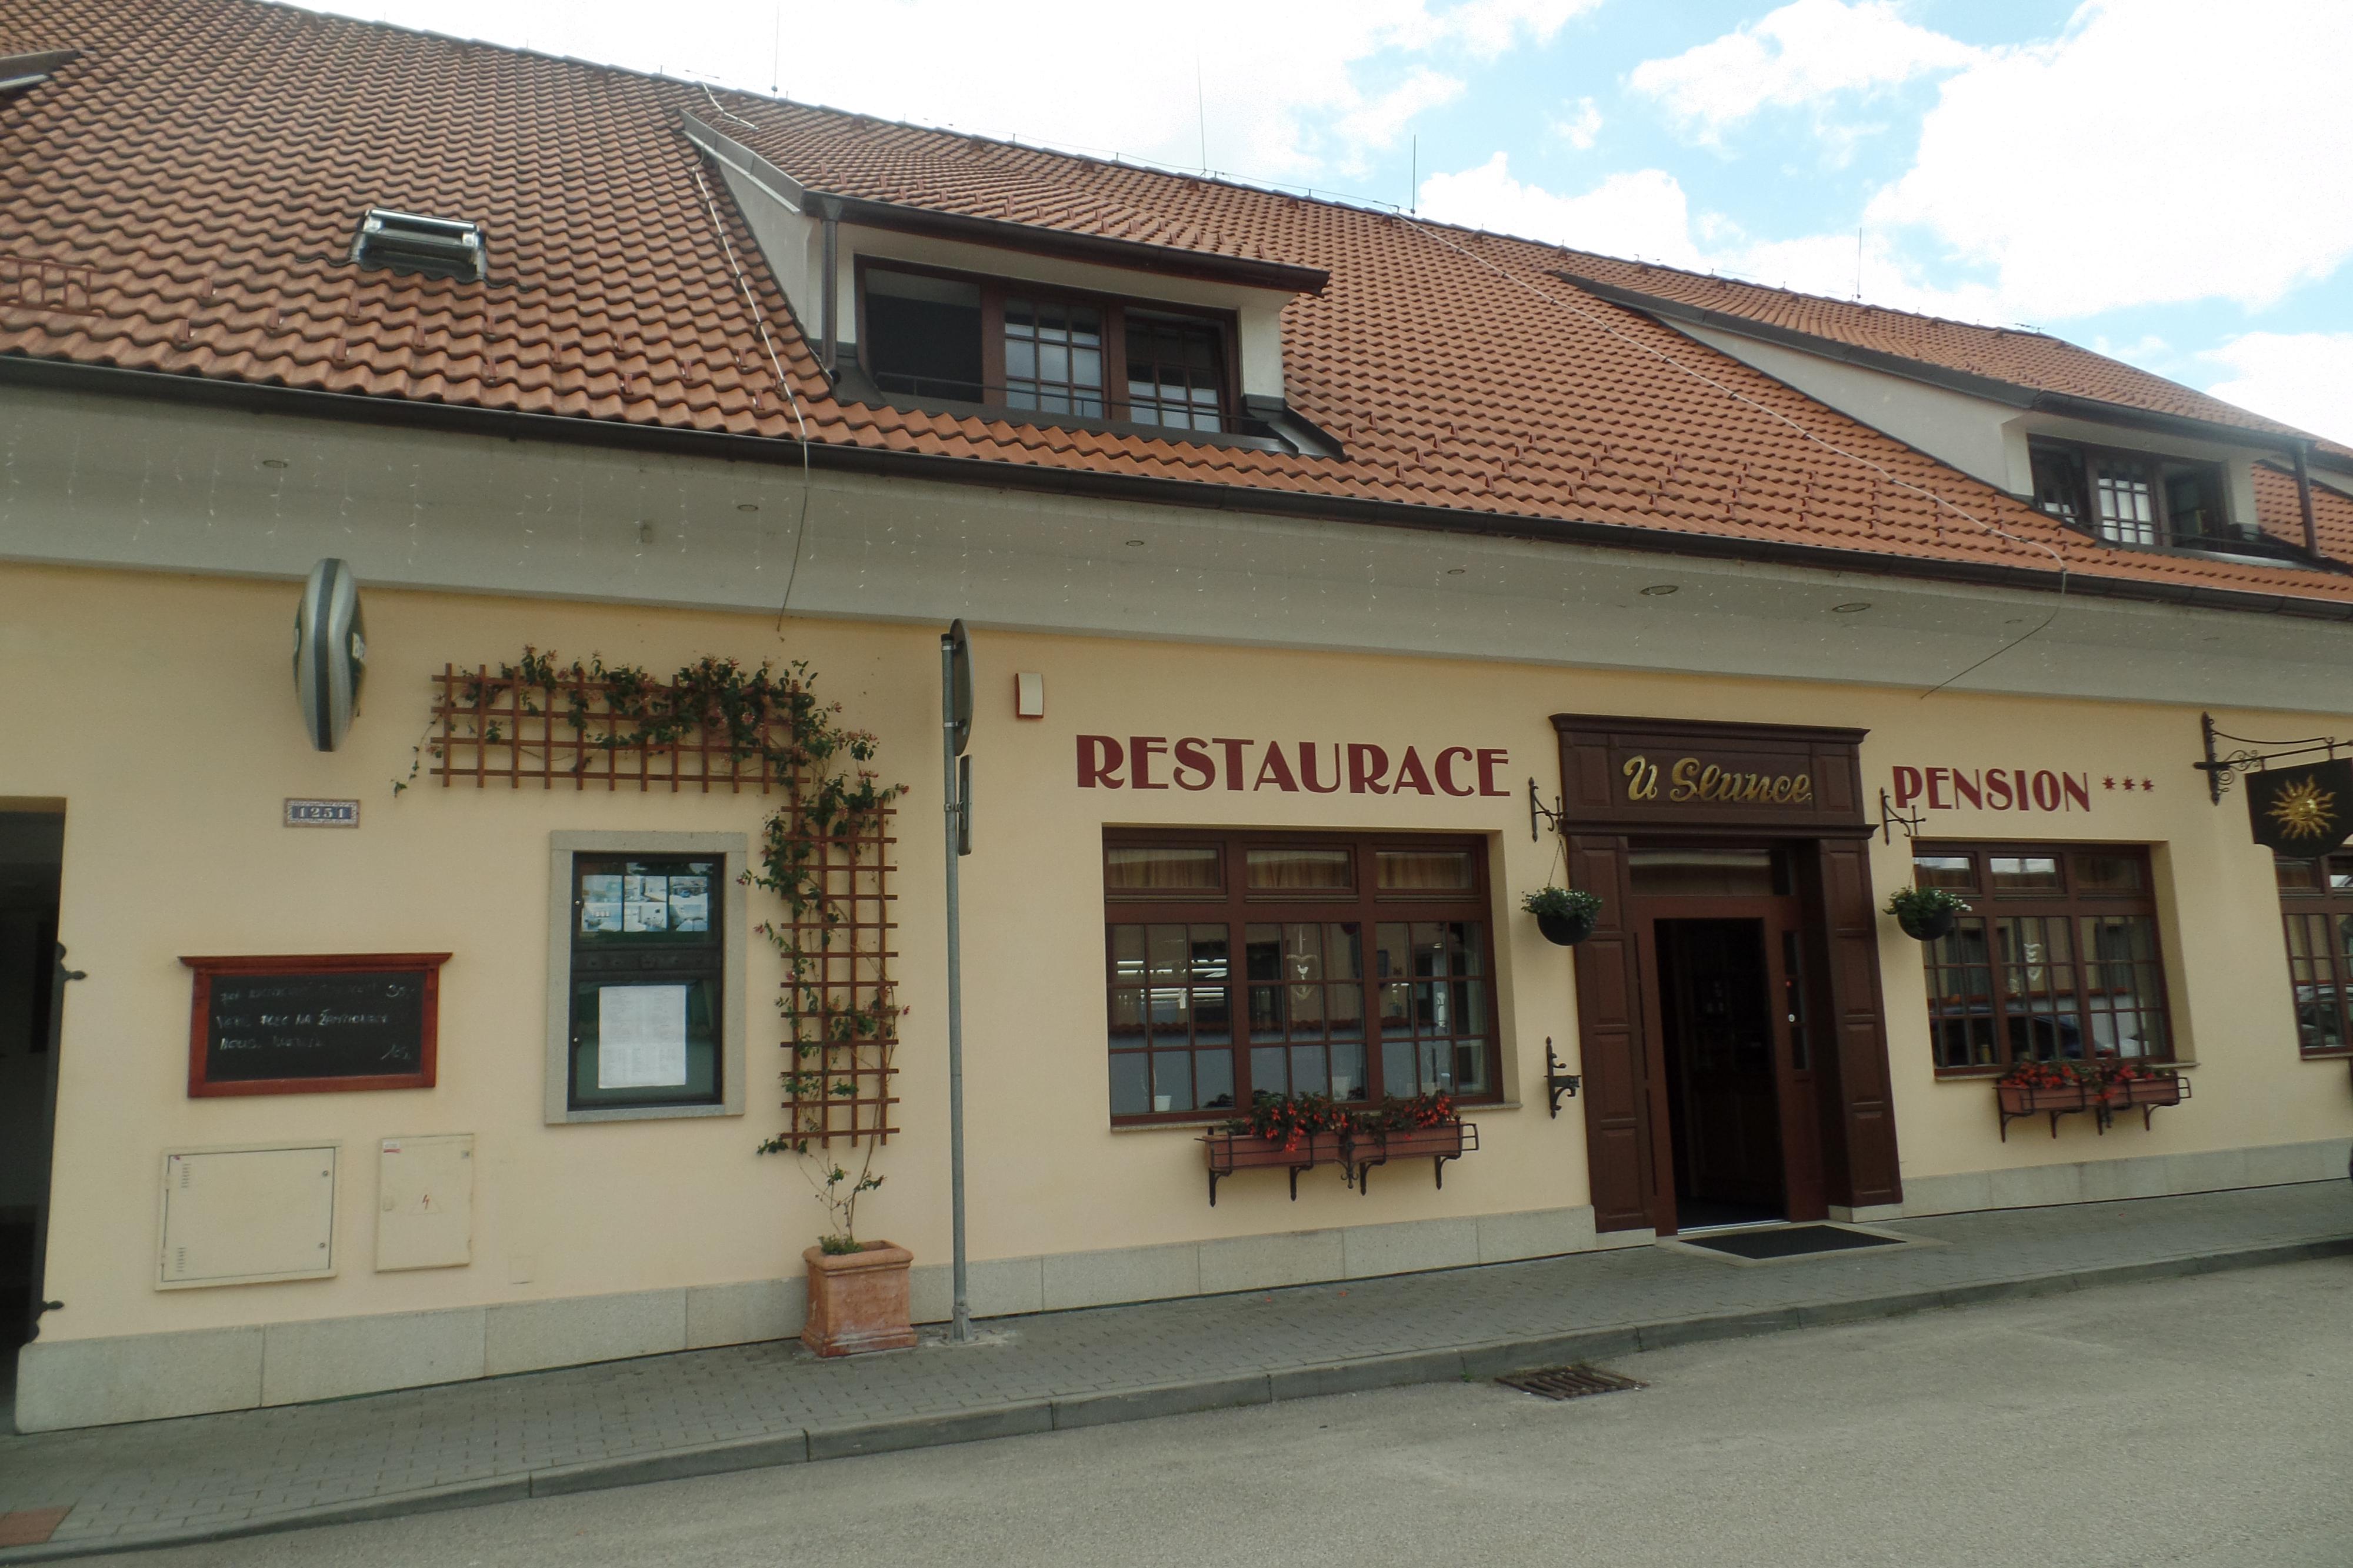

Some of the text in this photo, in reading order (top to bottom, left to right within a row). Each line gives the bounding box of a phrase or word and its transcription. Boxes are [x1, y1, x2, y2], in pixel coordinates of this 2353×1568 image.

[1076, 734, 1511, 797] RESTAURACE
[1622, 754, 1812, 803] U Slunce
[1892, 765, 2091, 812] PENSION
[299, 806, 344, 818] 1251
